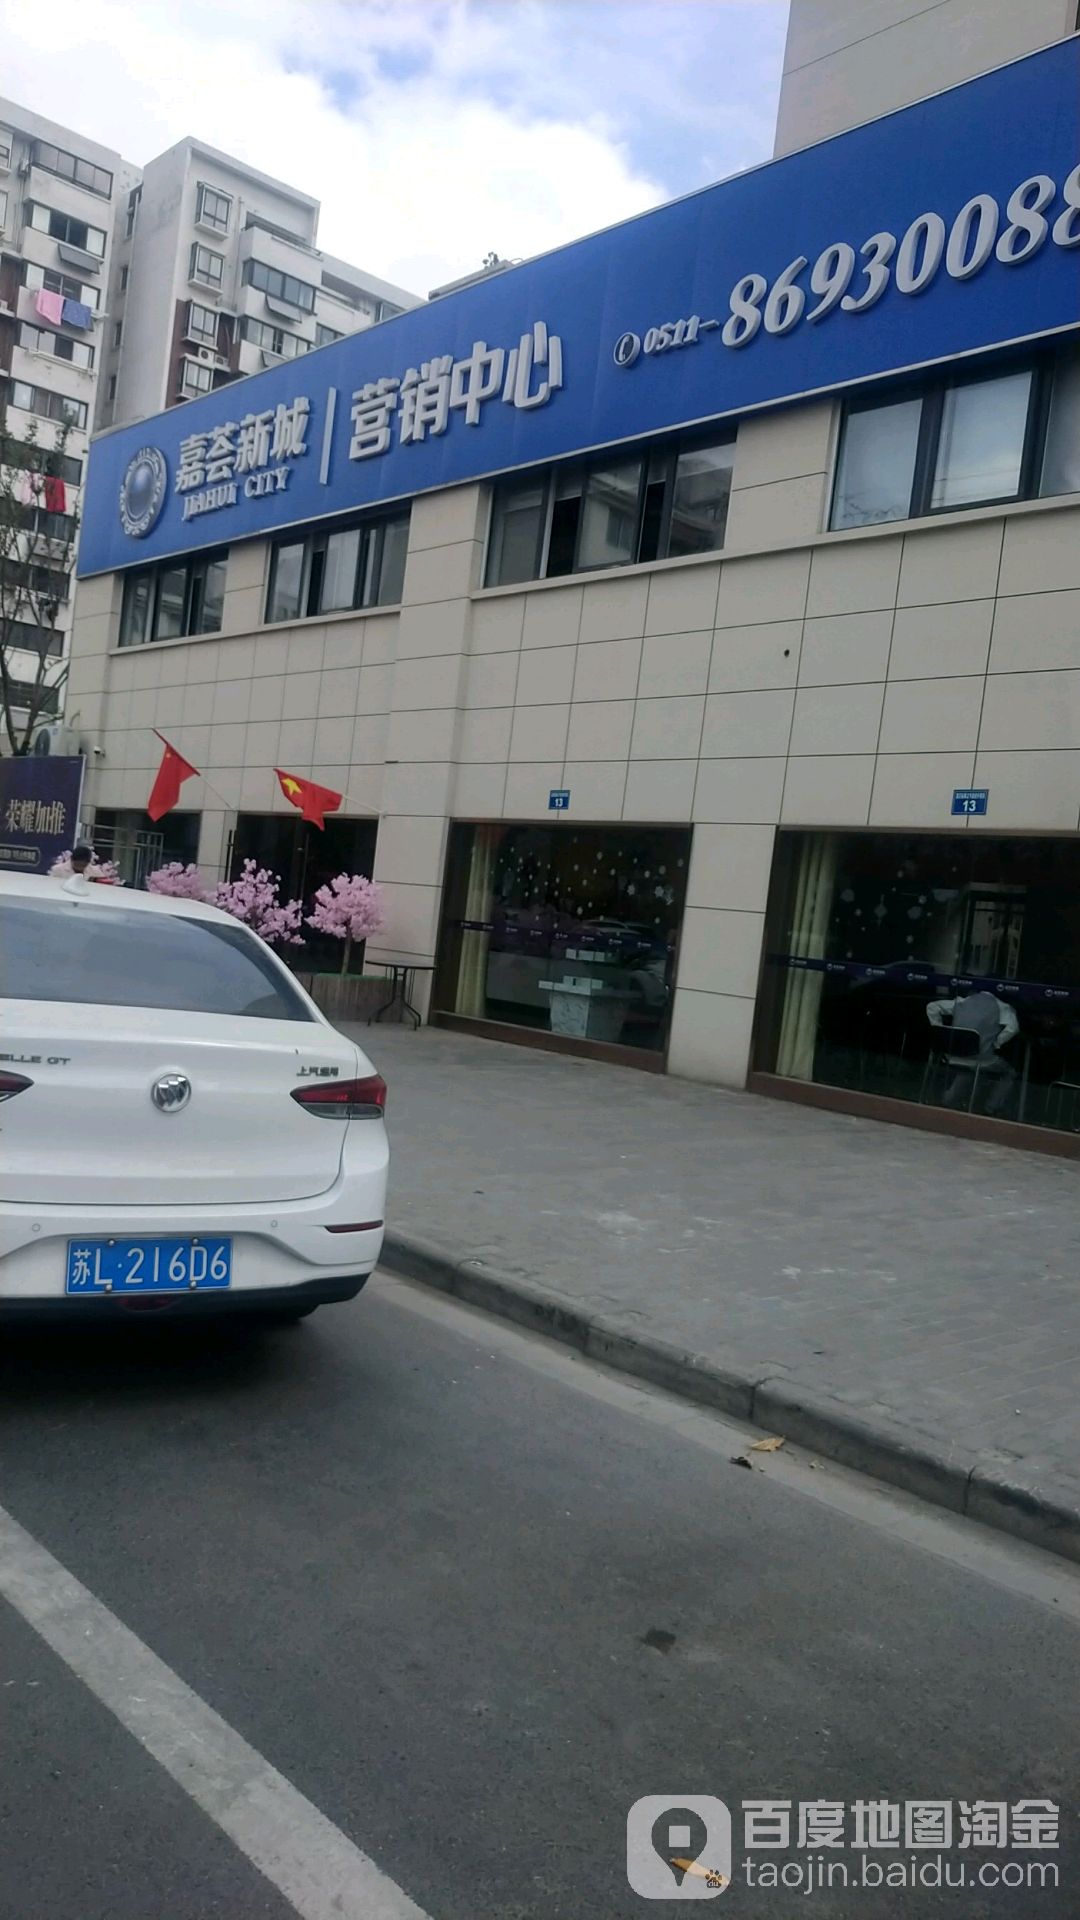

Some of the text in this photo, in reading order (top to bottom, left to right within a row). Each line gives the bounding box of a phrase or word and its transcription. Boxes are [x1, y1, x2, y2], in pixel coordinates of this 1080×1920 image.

[348, 321, 563, 461] 营销中心
[175, 397, 310, 494] 嘉荟新城
[244, 466, 291, 498] CITY
[554, 798, 564, 807] 13
[962, 799, 977, 812] 13
[47, 1056, 71, 1065] GT
